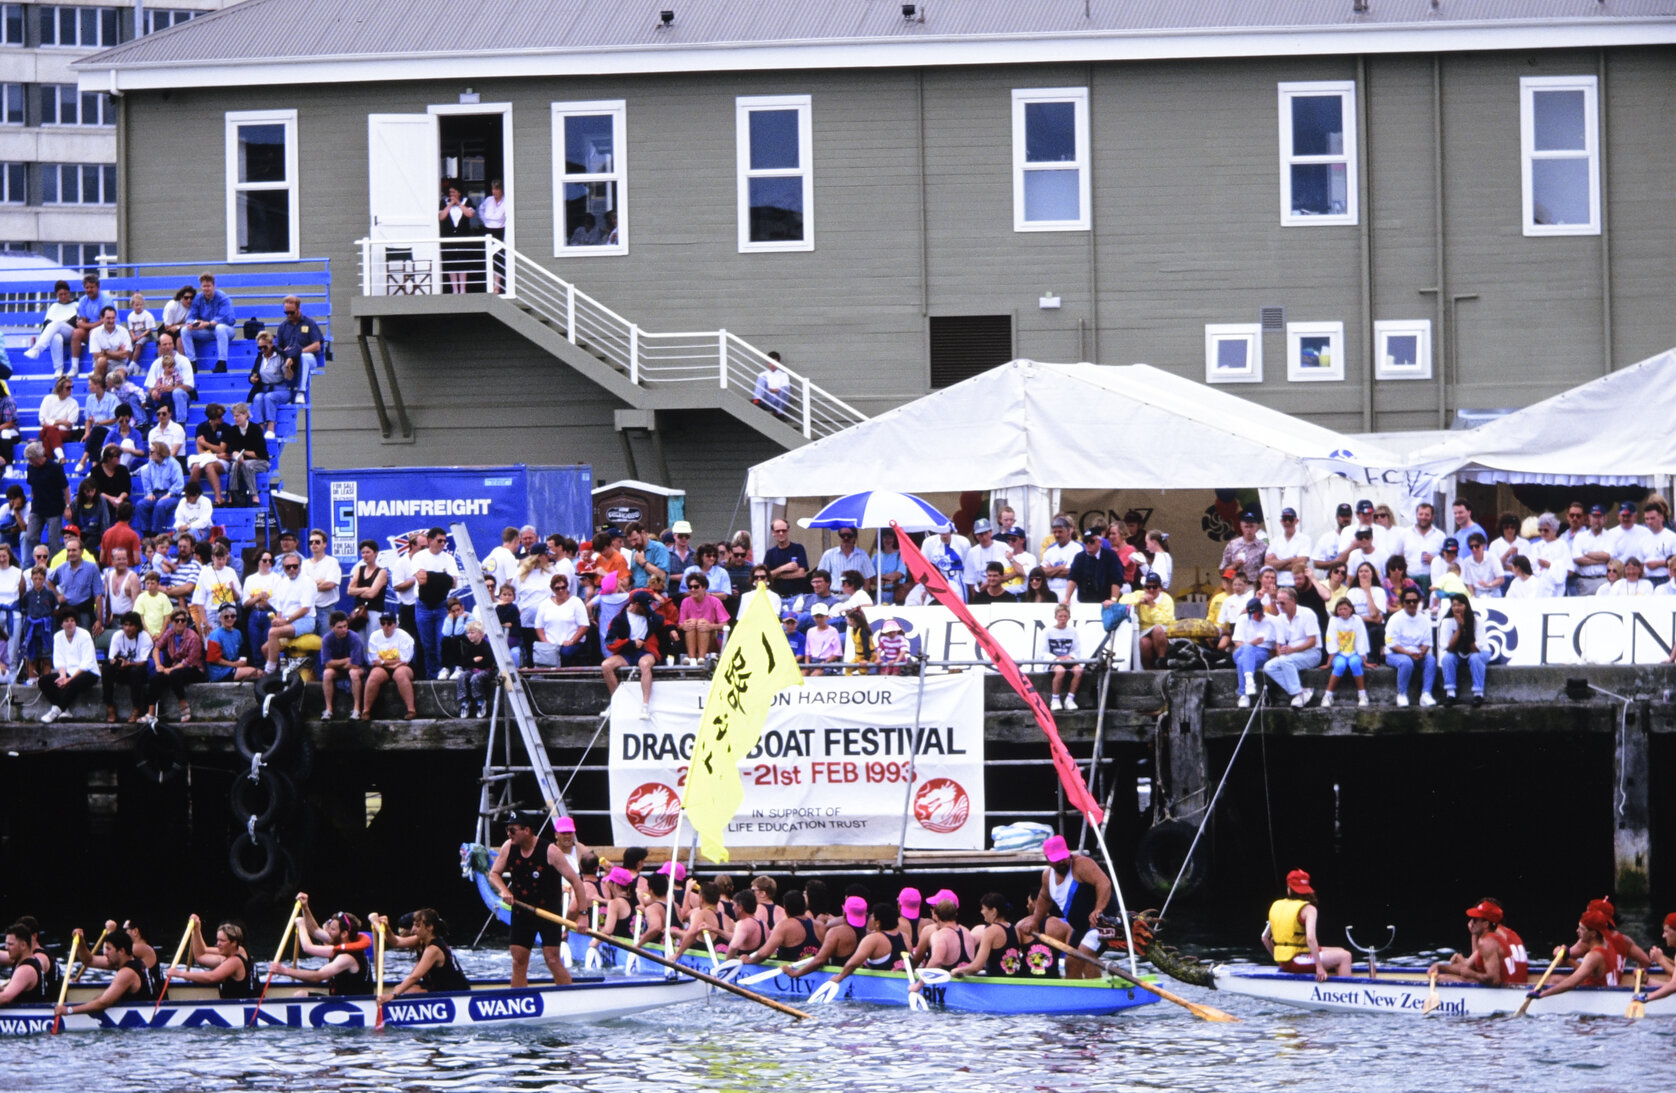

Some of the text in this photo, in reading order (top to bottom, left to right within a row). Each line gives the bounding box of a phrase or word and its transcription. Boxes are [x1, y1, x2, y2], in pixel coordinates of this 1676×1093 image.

[357, 499, 492, 517] MAINFREIGHT
[799, 690, 892, 705] HARBOUR
[622, 733, 697, 761] DRAG
[824, 727, 967, 756] FESTIVAL
[811, 762, 859, 784] FEB
[865, 761, 918, 784] 1993
[752, 807, 841, 819] IN SUPPORT OF
[728, 820, 868, 833] LIFE EDUCATION TRUST
[1310, 986, 1359, 1005] Ansett
[1364, 990, 1398, 1007] New
[388, 1003, 449, 1022] WANG
[475, 997, 537, 1017] WANG
